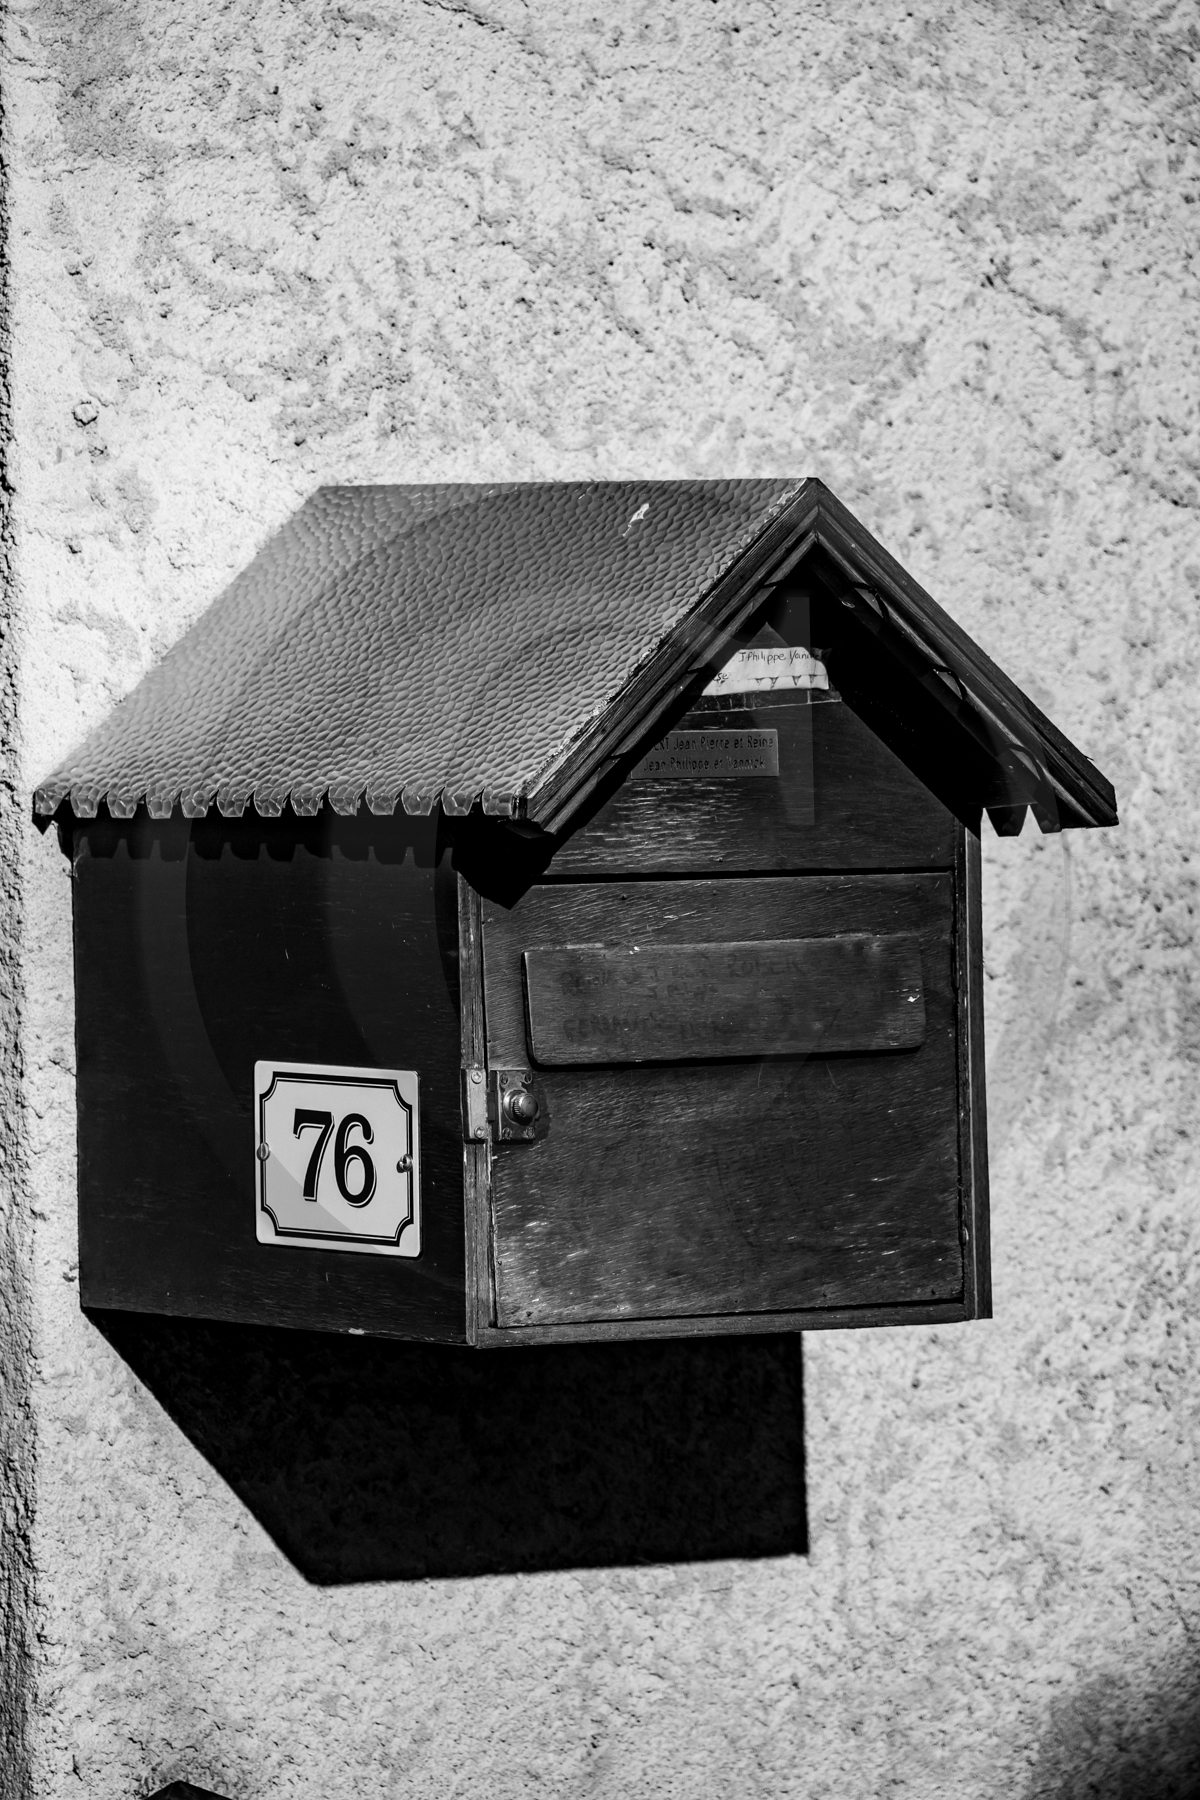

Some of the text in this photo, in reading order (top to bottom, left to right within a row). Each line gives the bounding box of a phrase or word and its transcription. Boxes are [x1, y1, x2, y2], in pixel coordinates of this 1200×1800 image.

[674, 737, 697, 751] Jean
[700, 735, 730, 751] Pierre
[734, 737, 744, 749] et
[747, 735, 774, 750] Reine
[643, 756, 766, 774] Jean Philippe et Yannick
[293, 1108, 377, 1208] 76
